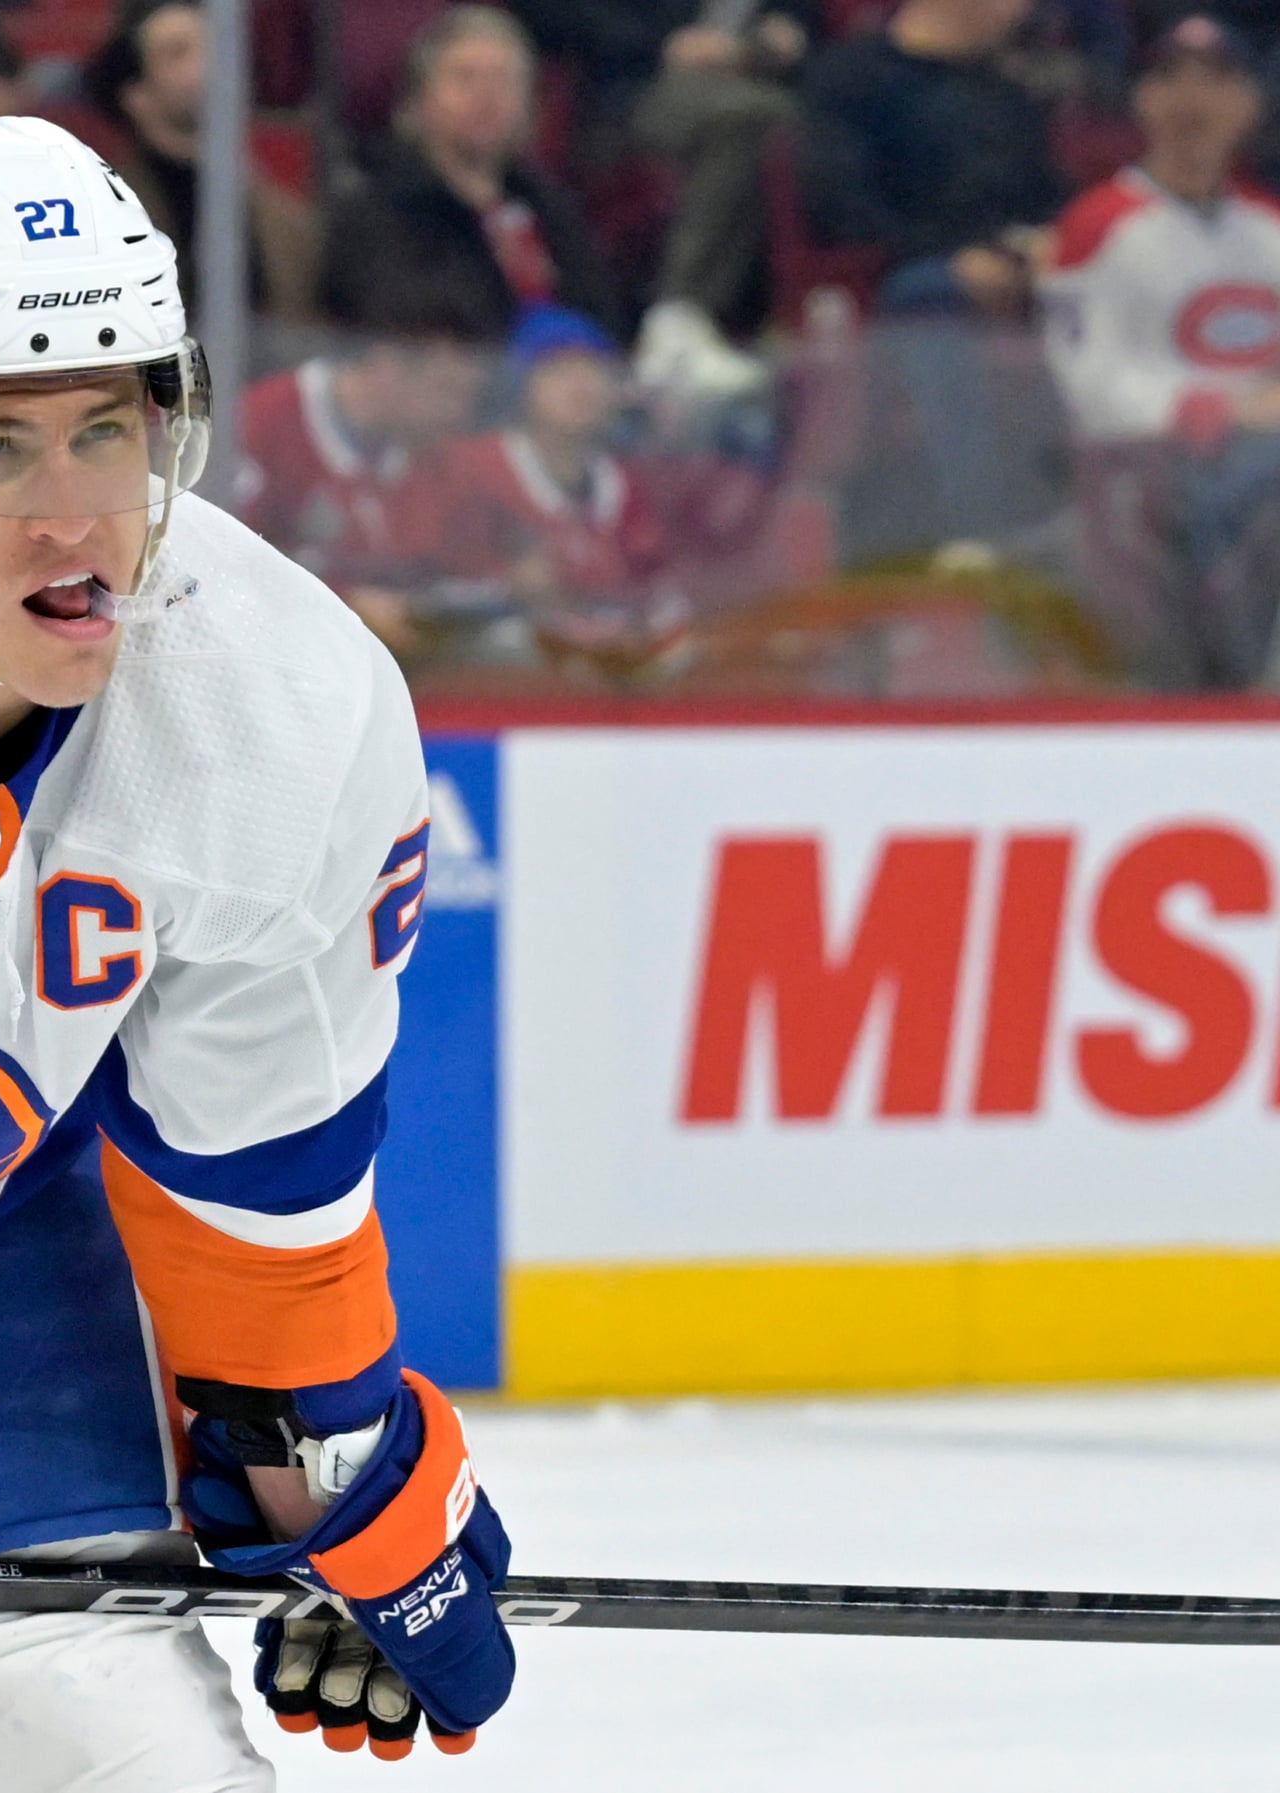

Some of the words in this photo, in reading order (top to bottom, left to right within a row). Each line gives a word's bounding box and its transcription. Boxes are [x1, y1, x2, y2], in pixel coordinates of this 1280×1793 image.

[14, 198, 80, 242] 27
[17, 286, 122, 310] BAUER
[35, 868, 143, 1011] C
[677, 819, 1280, 1126] MIS
[377, 1547, 462, 1624] NEXUS
